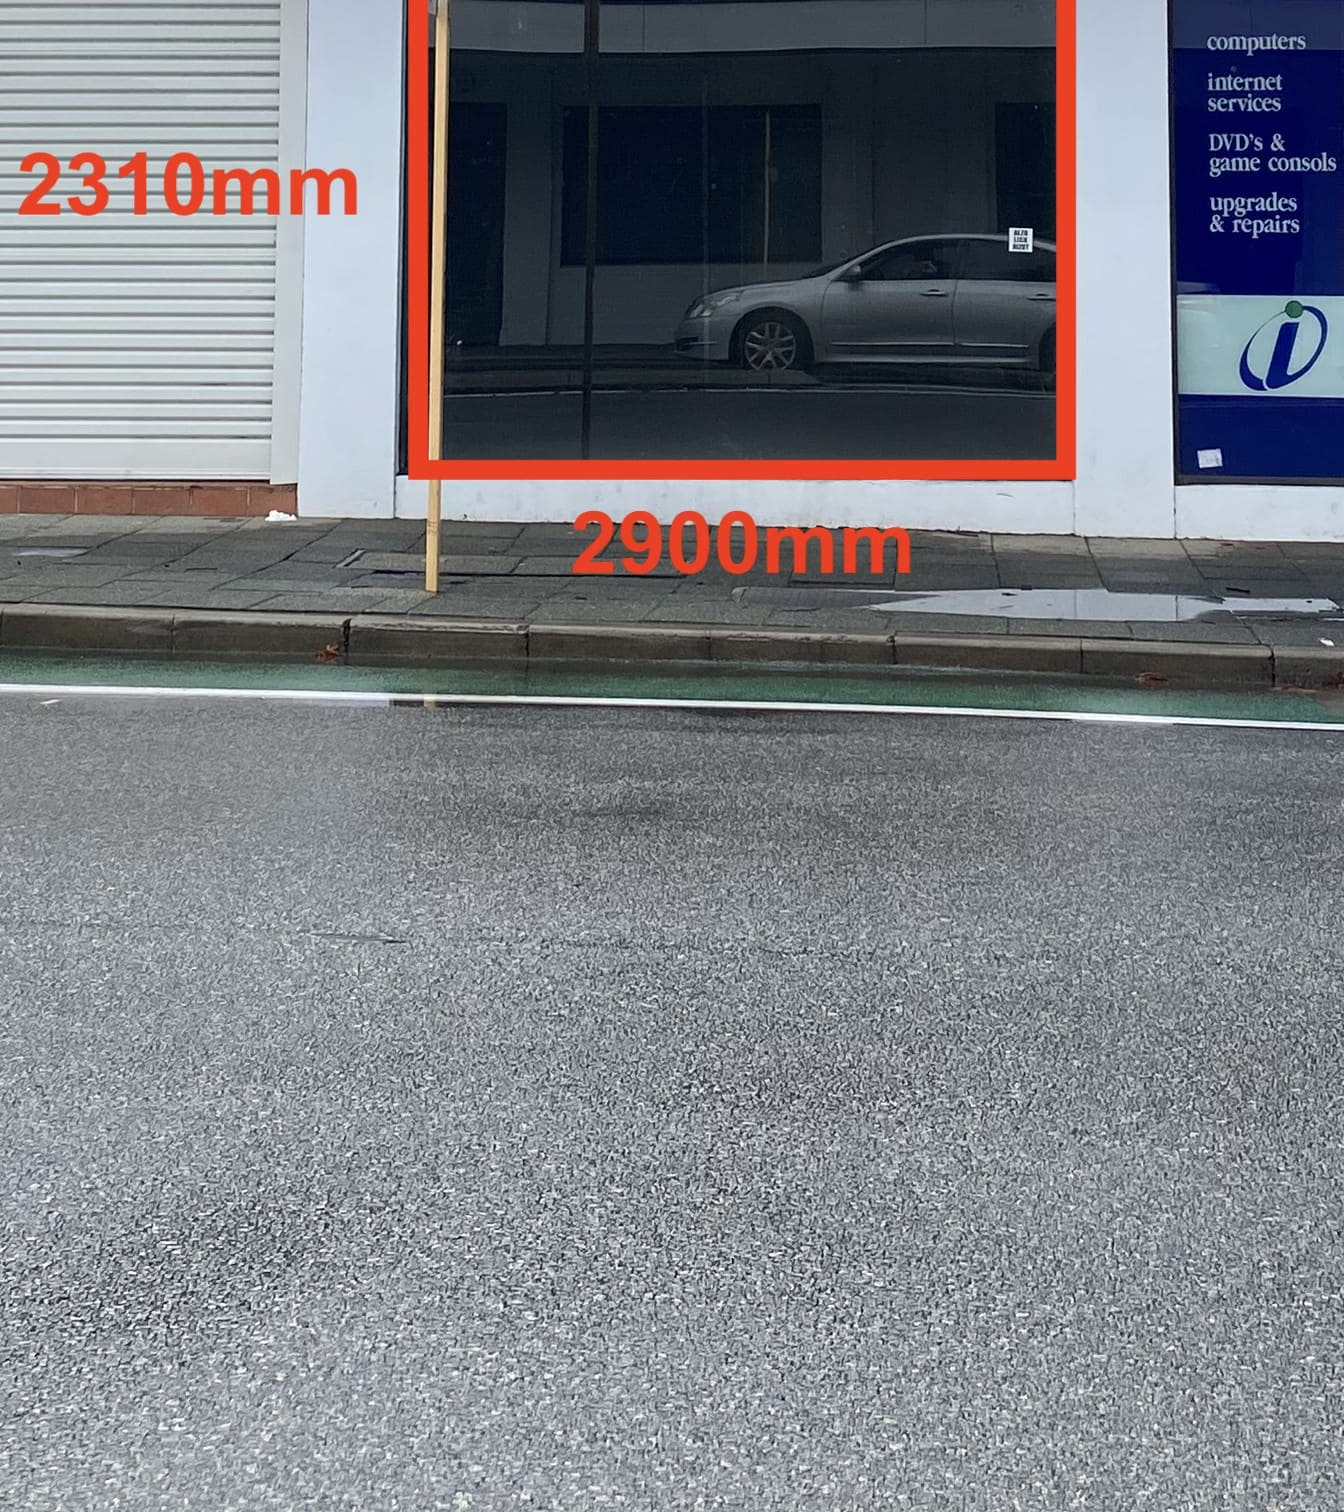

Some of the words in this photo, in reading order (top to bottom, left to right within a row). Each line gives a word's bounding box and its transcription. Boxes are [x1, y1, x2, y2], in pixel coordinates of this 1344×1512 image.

[1207, 34, 1306, 56] computers
[1208, 73, 1282, 91] internet
[1208, 94, 1281, 112] services
[1209, 134, 1263, 151] DVD's
[1270, 133, 1285, 151] &
[1209, 157, 1260, 177] game
[1268, 152, 1337, 172] consols
[1209, 192, 1297, 217] upgrades
[1209, 215, 1224, 233] &
[1232, 215, 1300, 239] repairs
